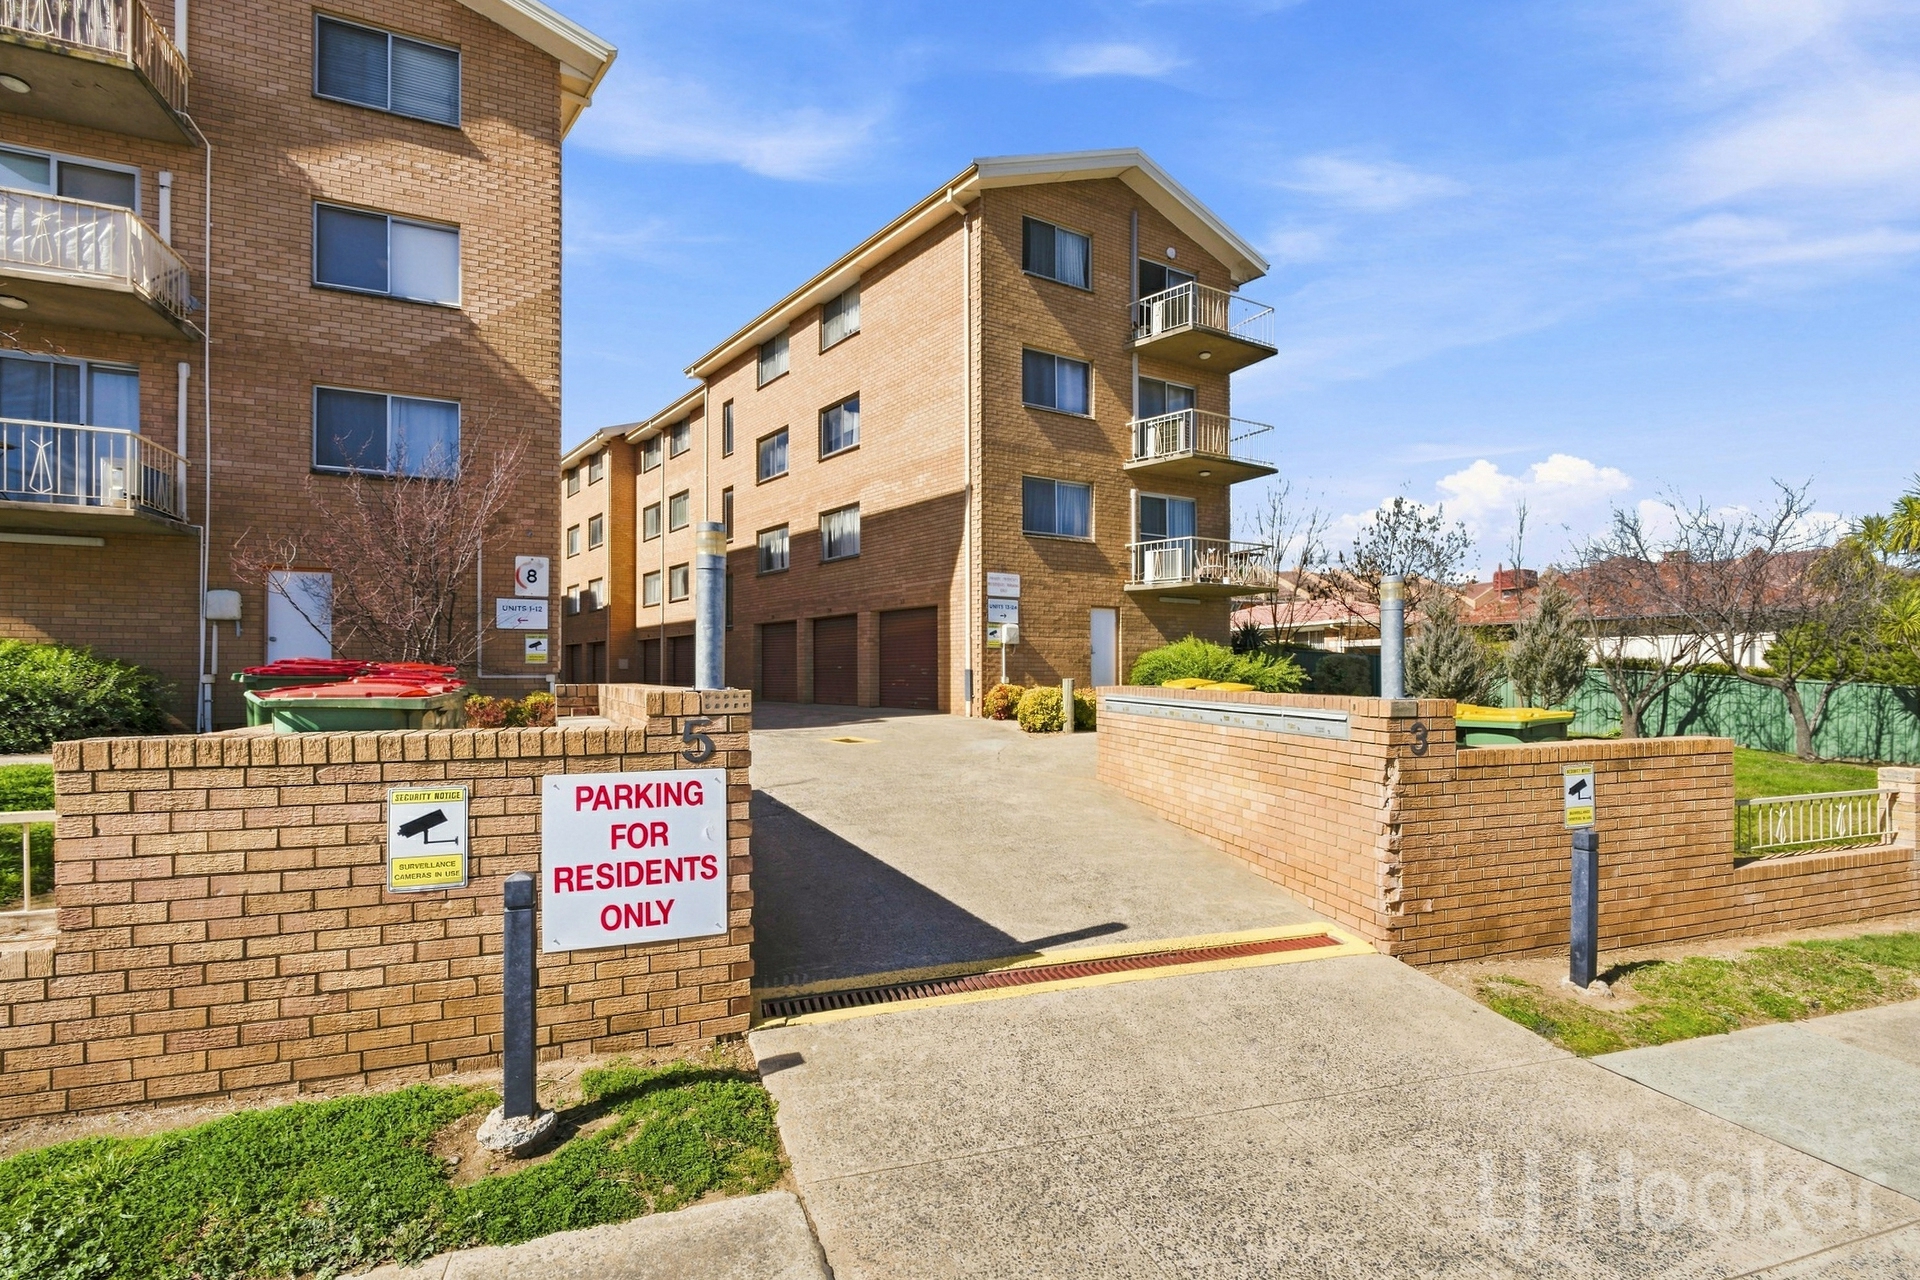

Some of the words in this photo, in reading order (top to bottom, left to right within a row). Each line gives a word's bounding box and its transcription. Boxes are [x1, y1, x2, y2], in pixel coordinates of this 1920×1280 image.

[527, 569, 537, 583] 8
[681, 717, 716, 763] 5
[1410, 721, 1428, 756] 3
[394, 792, 432, 802] SECURITY
[434, 791, 461, 800] NOTICE
[575, 780, 704, 811] PARKING
[611, 821, 669, 850] FOR
[394, 872, 432, 881] CAMERAS
[398, 860, 456, 871] SURVEILLANCE
[554, 855, 718, 893] RESIDENTS
[600, 899, 675, 931] ONLY
